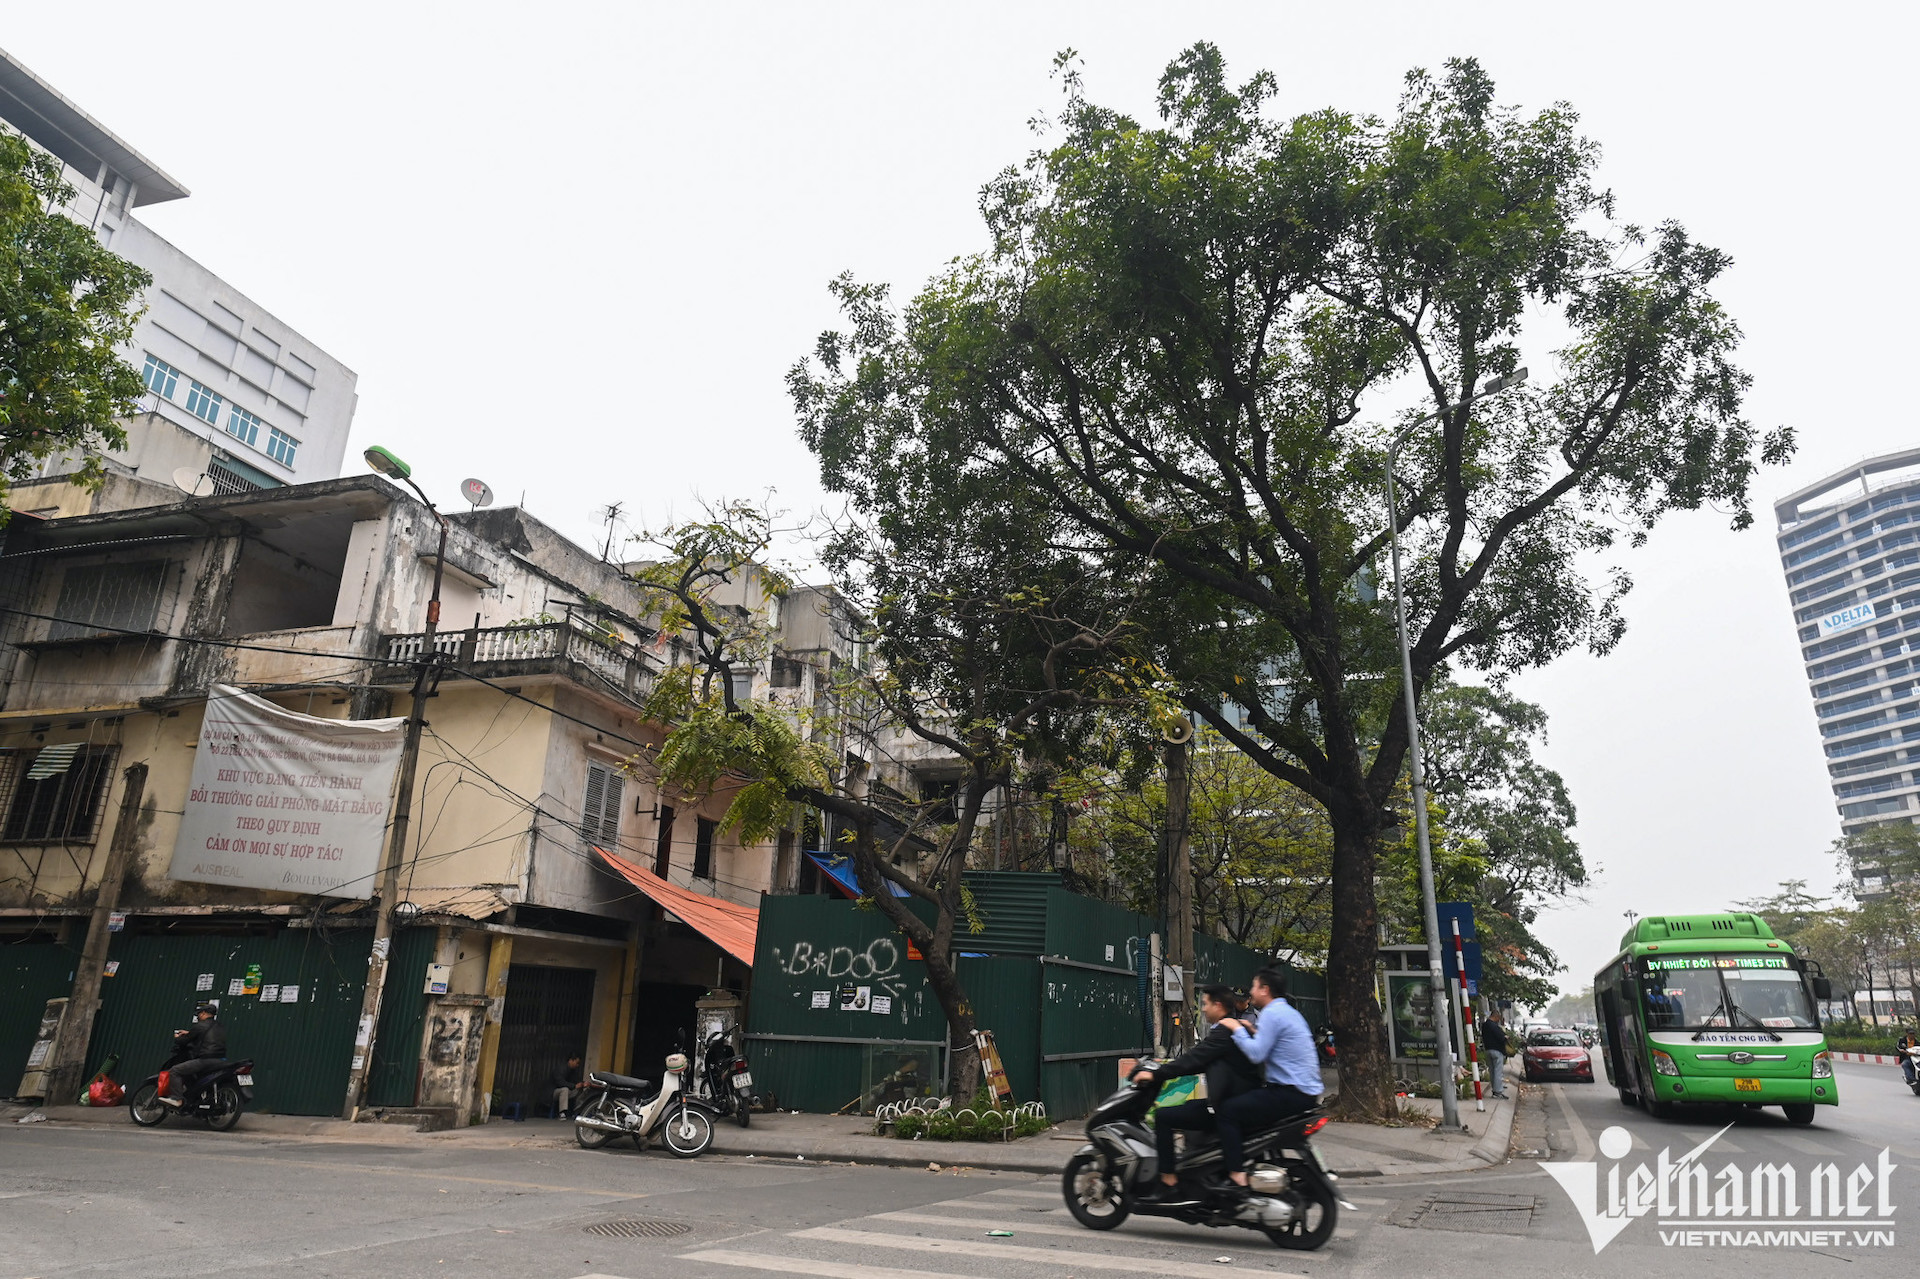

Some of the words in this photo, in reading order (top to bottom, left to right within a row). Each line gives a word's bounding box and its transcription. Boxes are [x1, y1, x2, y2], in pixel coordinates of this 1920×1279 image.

[1832, 604, 1872, 626] DELTA
[217, 768, 240, 782] KHU
[243, 770, 263, 786] VỰC
[266, 773, 295, 787] ĐANG
[329, 774, 363, 790] HÀNH
[256, 790, 280, 808] GIẢI
[322, 797, 349, 815] MẶT
[236, 816, 263, 831] THEO
[266, 819, 290, 835] QUY
[292, 821, 321, 837] ĐỊNH
[206, 833, 230, 852] CẢM
[232, 836, 247, 850] ƠN
[249, 841, 270, 858] MỌI
[273, 842, 290, 859] SỰ
[290, 842, 314, 860] HỢP
[317, 842, 343, 861] TÁC!
[193, 863, 243, 879] AUSREAL
[1648, 959, 1661, 971] BV
[1734, 958, 1764, 968] TIMES
[1766, 957, 1787, 968] CITY
